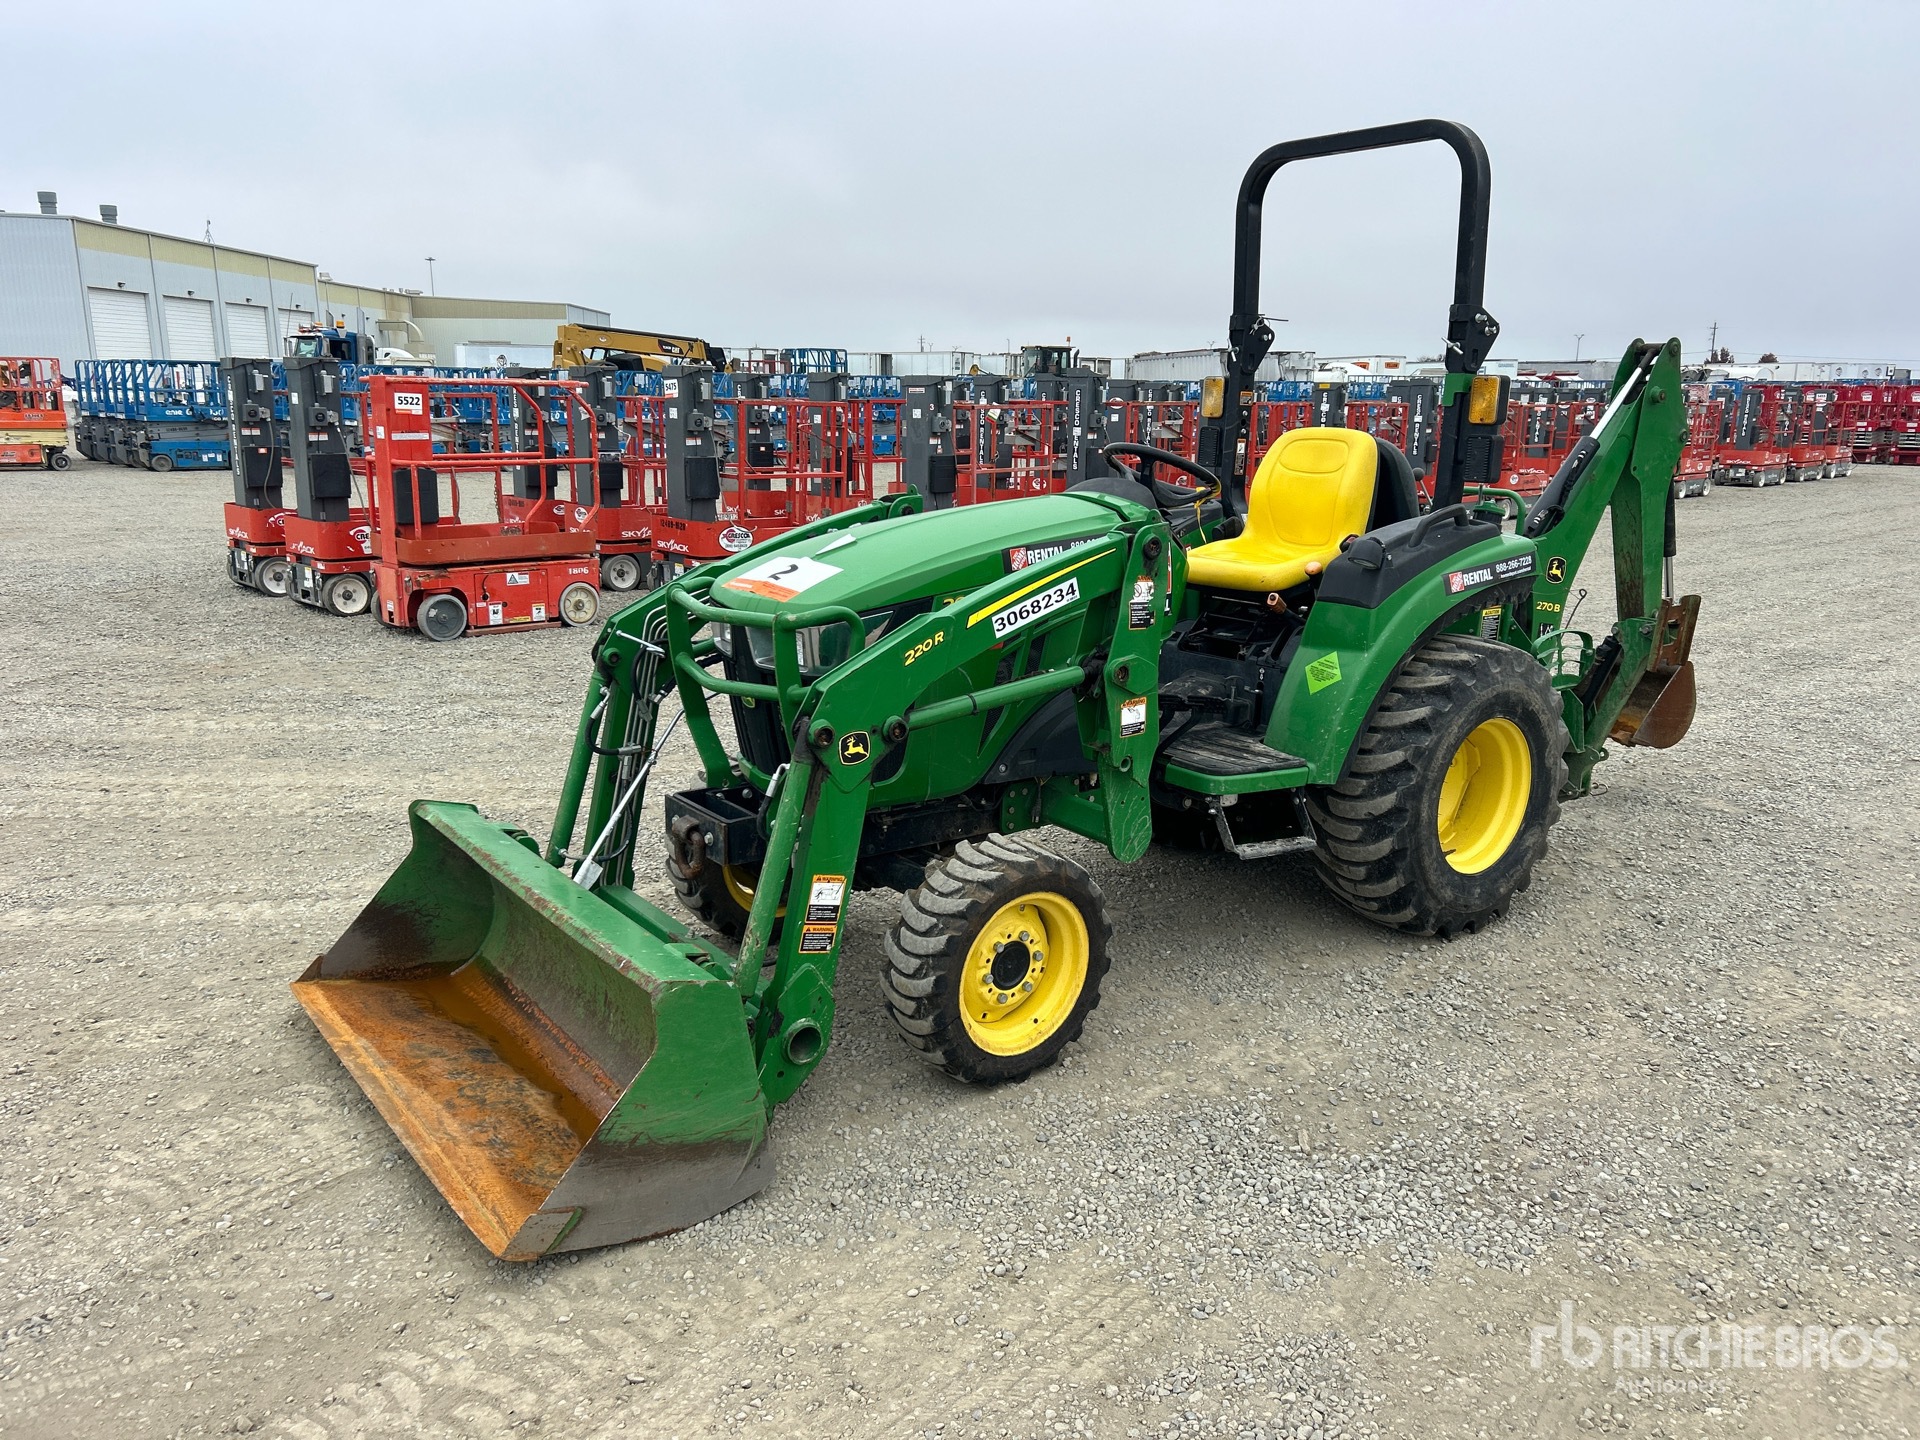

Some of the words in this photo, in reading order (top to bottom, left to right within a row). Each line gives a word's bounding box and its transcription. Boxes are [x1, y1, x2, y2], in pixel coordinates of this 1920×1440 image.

[665, 382, 677, 391] 5475
[397, 395, 421, 406] 5522
[929, 403, 936, 411] 3
[1074, 389, 1082, 427] CRESCO
[656, 538, 690, 553] SKYJACK
[568, 566, 590, 575] 1806
[767, 563, 799, 581] 2
[1462, 567, 1494, 587] RENTAL
[994, 582, 1077, 633] 3068234
